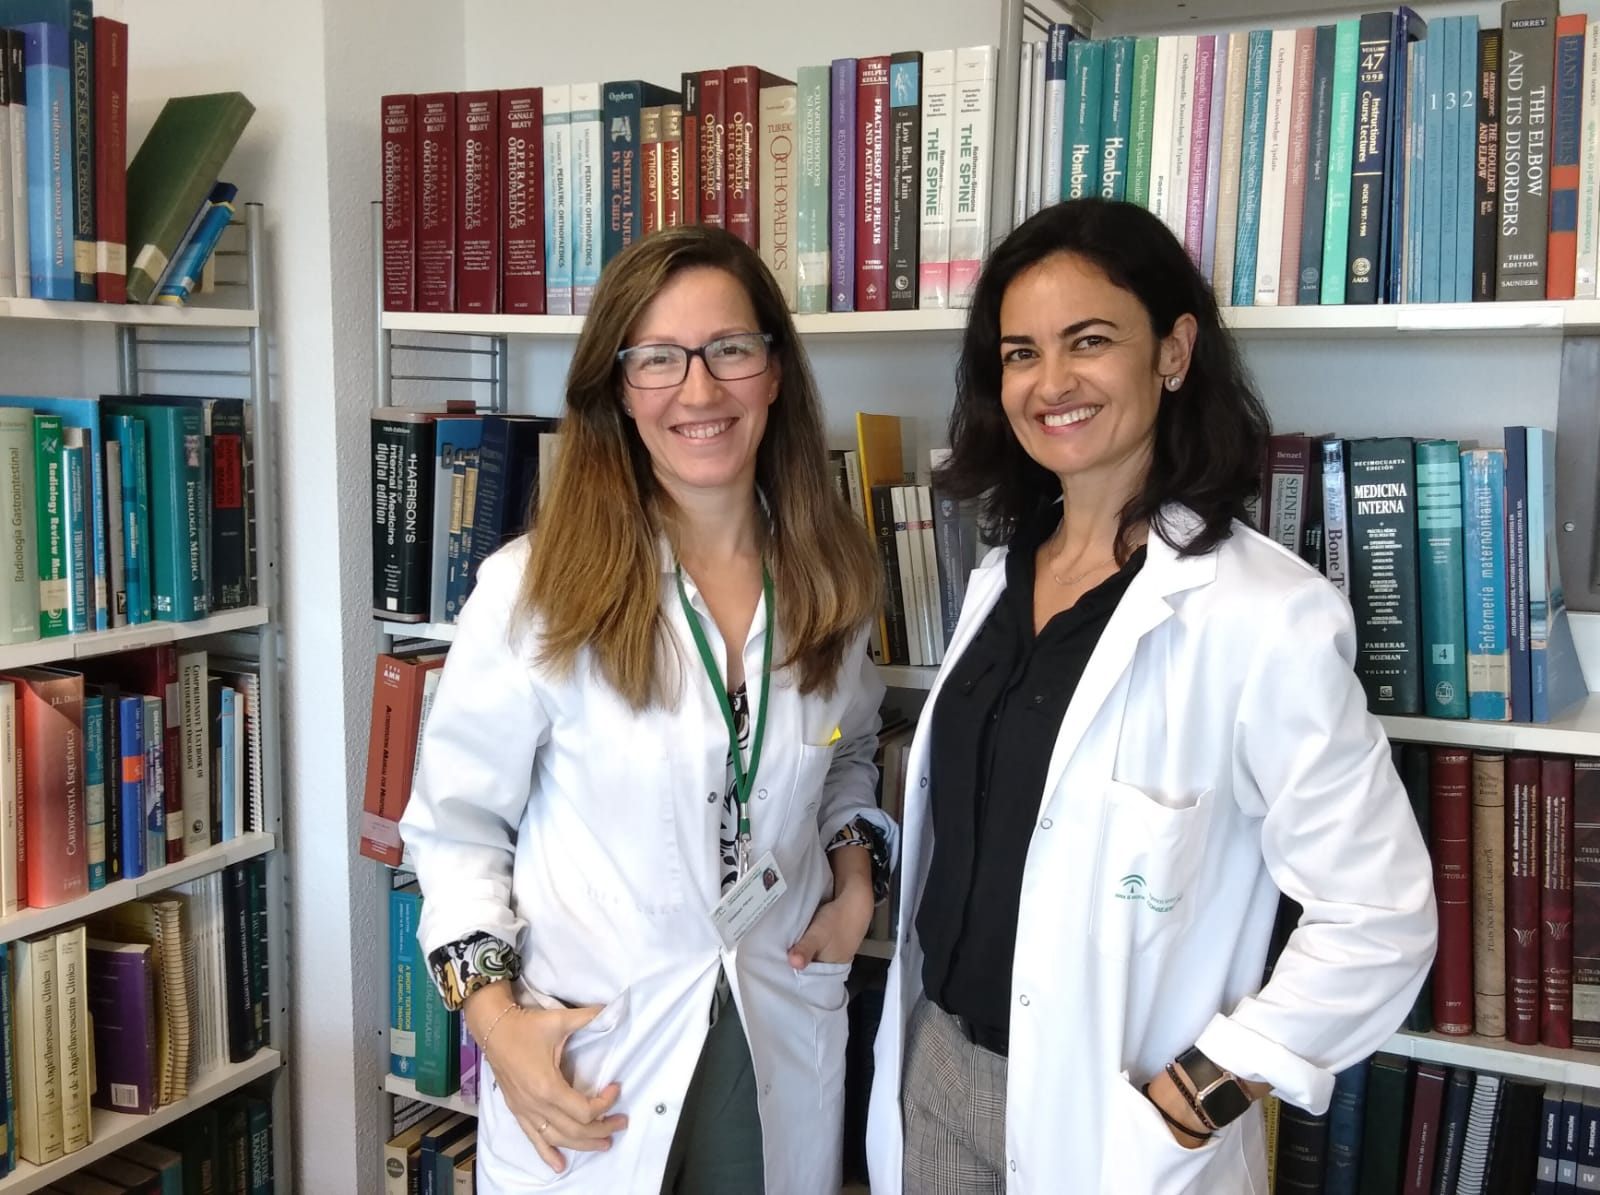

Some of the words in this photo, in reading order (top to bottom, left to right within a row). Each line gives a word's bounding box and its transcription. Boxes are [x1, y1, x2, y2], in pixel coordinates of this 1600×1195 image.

[1511, 19, 1546, 28] MORREY
[77, 43, 86, 78] ATLAS
[1139, 55, 1151, 97] Orthopaedic
[1361, 54, 1384, 70] 47
[1361, 73, 1383, 82] 1998
[1508, 50, 1524, 90] AND
[78, 80, 88, 95] OF
[1430, 94, 1437, 110] 1
[1445, 93, 1456, 110] 3
[1462, 92, 1472, 108] 2
[1530, 86, 1546, 125] THE
[508, 112, 534, 122] CANALE
[1136, 100, 1148, 141] Knowledge
[1360, 91, 1372, 124] Course
[1369, 98, 1381, 154] Instructional
[1506, 97, 1523, 126] ITS
[79, 99, 89, 156] SURGICAL
[902, 122, 912, 142] Low
[927, 128, 938, 161] THE
[960, 124, 972, 158] THE
[1359, 125, 1370, 162] Lectures
[1479, 123, 1488, 143] AND
[1488, 123, 1497, 141] THE
[612, 151, 620, 163] IN
[648, 150, 656, 189] RODILLA
[705, 114, 715, 200] ORTHOPAEDIC
[715, 124, 723, 180] Complications
[733, 112, 744, 199] ORTHOPAEDIC
[744, 123, 752, 180] Complications
[838, 130, 846, 171] REVISION
[902, 147, 912, 172] Back
[1102, 137, 1123, 198] Hombro
[1478, 146, 1487, 178] ELBOW
[1487, 144, 1496, 193] SHOULDER
[1527, 130, 1544, 197] ELBOW
[465, 139, 475, 230] ORTHOPAEDICS
[474, 142, 482, 228] OPERATIVE
[508, 137, 518, 230] ORTHOPAEDICS
[517, 139, 527, 227] OPERATIVE
[612, 168, 620, 190] THE
[623, 150, 633, 207] SKELETAL
[838, 174, 846, 201] TOTAL
[864, 149, 872, 223] ACETABULUM
[901, 176, 912, 200] Pain
[958, 164, 972, 213] SPINE
[1070, 144, 1089, 199] Hombro
[1134, 171, 1144, 202] Shoulder
[1502, 132, 1522, 237] DISORDERS
[80, 160, 91, 234] OPERATIONS
[672, 186, 679, 200] LA
[770, 136, 792, 270] ORTHOPAEDICS
[838, 204, 846, 218] HIP
[925, 167, 938, 216] SPINE
[612, 195, 621, 231] CHILD
[873, 207, 881, 244] PELVIS
[1360, 205, 1368, 237] 1997-1998
[837, 222, 846, 285] ARTHROPLASTY
[1502, 279, 1538, 287] SAUNDERS
[375, 443, 388, 480] digital
[389, 444, 397, 489] Internal
[48, 463, 59, 514] Radiology
[376, 484, 387, 524] edition
[397, 492, 403, 504] OF
[406, 459, 418, 543] HARRISON'S
[1285, 477, 1298, 520] SPINE
[1354, 483, 1407, 499] MEDICINA
[1358, 500, 1405, 515] INTERNA
[186, 482, 196, 538] FISIOLOGÍA
[388, 492, 396, 545] Medicine
[50, 518, 59, 554] Review
[1328, 528, 1343, 570] Bone
[1475, 488, 1493, 578] maternoinfantil
[190, 542, 199, 581] MÉDICA
[1477, 586, 1495, 650] Enfermería
[1439, 649, 1448, 659] 4
[192, 665, 202, 726] COMPREHENSIVE
[384, 671, 400, 681] AMH
[184, 667, 192, 727] GENITOURINARY
[384, 705, 393, 748] ACCREDITATION
[65, 728, 75, 785] ISQUÉMICA
[195, 728, 203, 767] TEXTBOOK
[381, 749, 390, 775] MANUAL
[197, 770, 203, 778] OF
[65, 789, 76, 855] CARDIOPATÍA
[379, 788, 387, 818] HOSPITAL
[398, 965, 404, 973] OF
